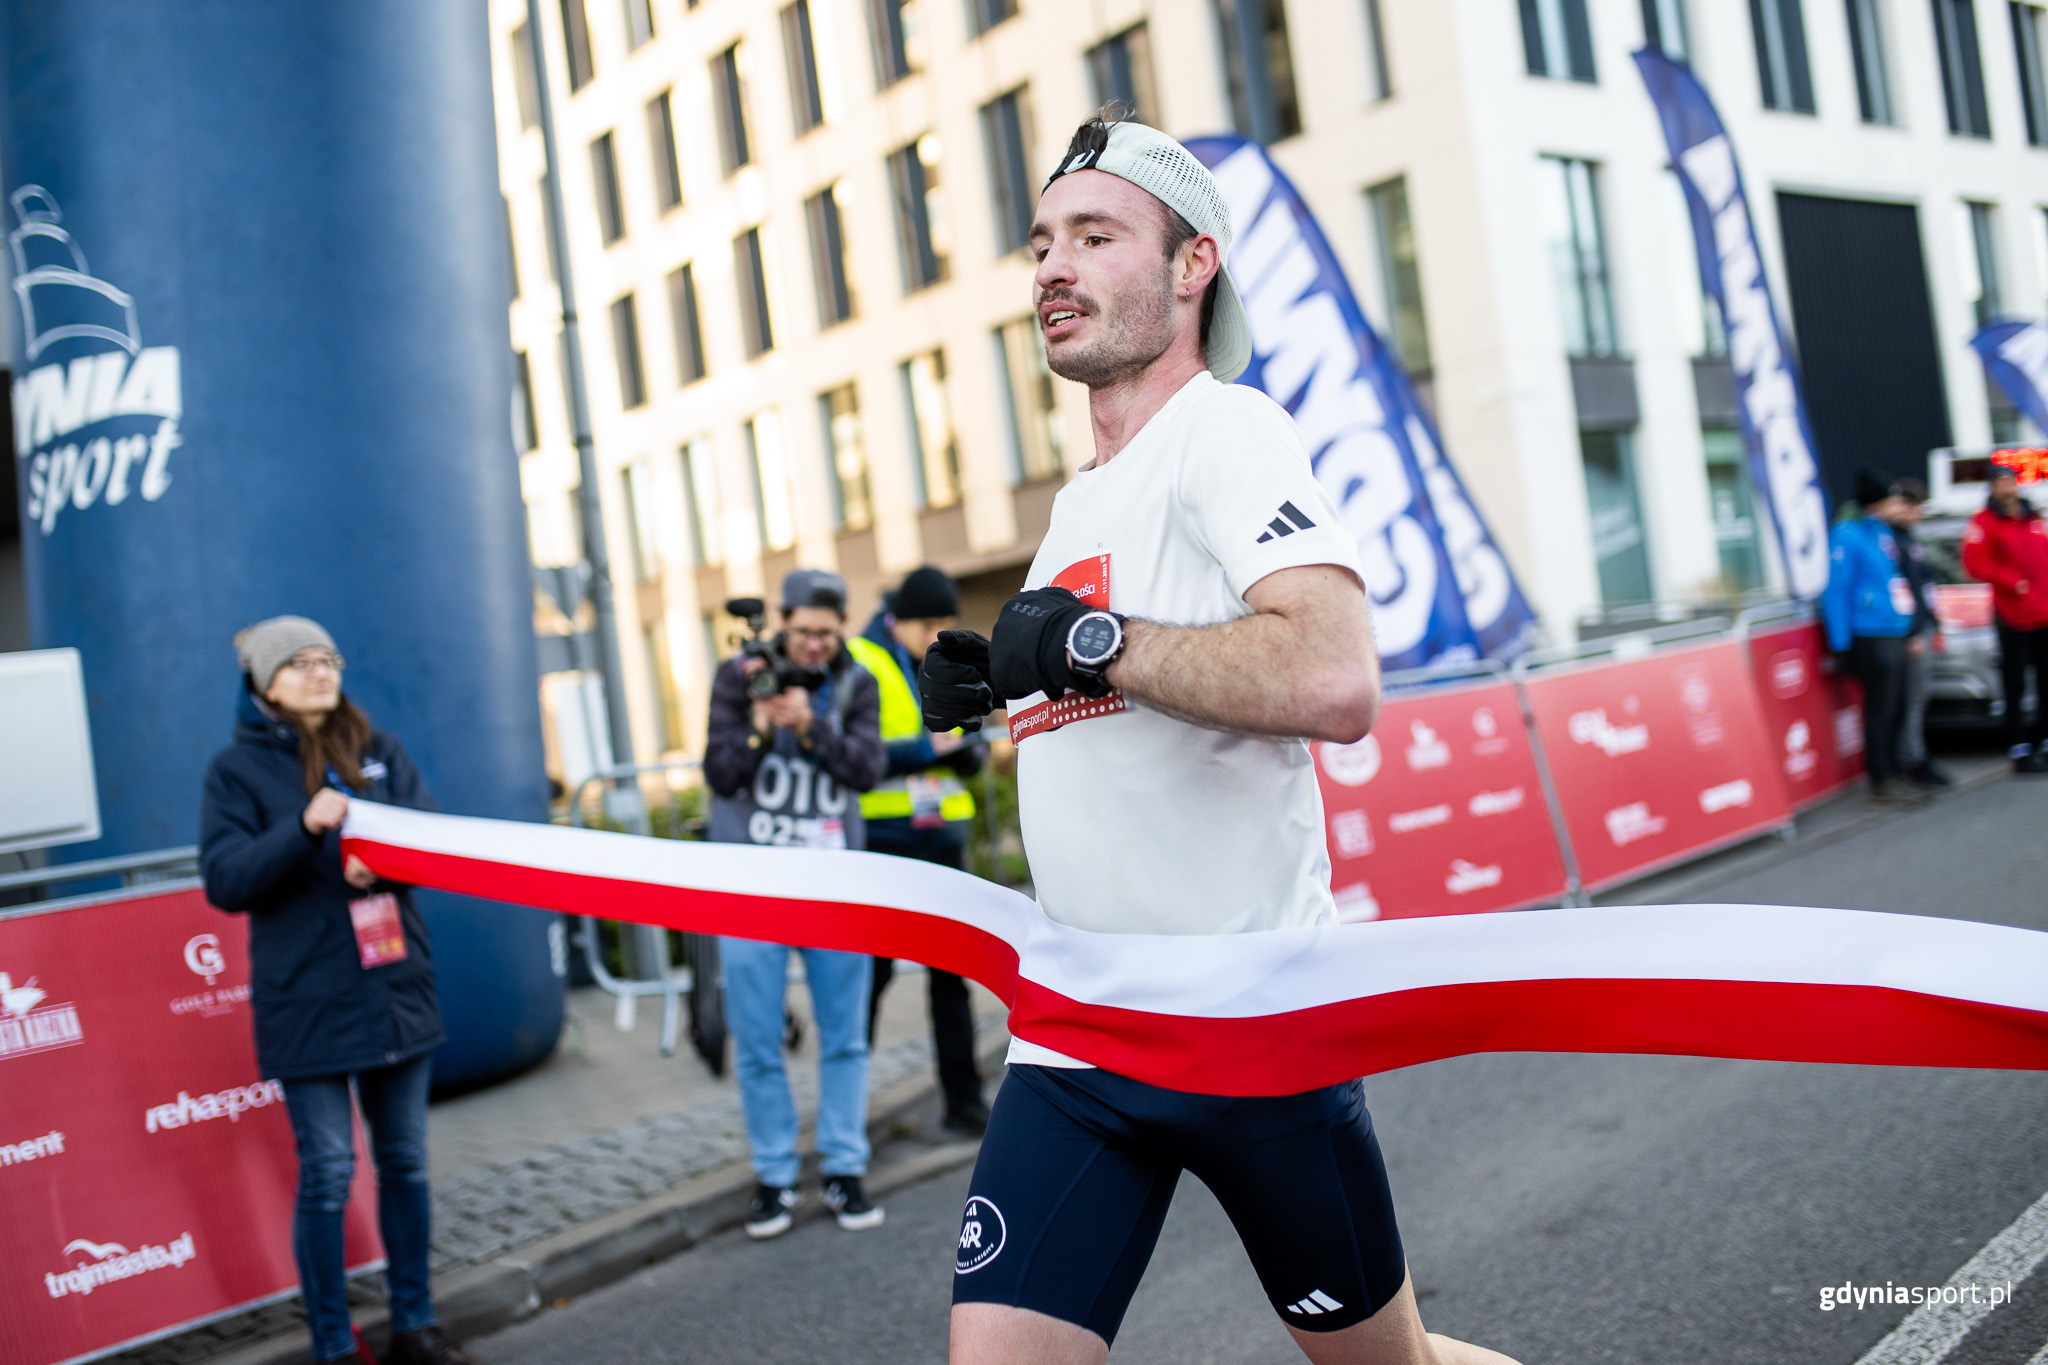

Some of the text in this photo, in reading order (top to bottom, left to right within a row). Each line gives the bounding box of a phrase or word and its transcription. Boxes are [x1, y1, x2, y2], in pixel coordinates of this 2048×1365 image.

[28, 418, 184, 536] sport
[1070, 583, 1096, 599] GŁOŚCI
[45, 1232, 196, 1299] trojmiasto.pl
